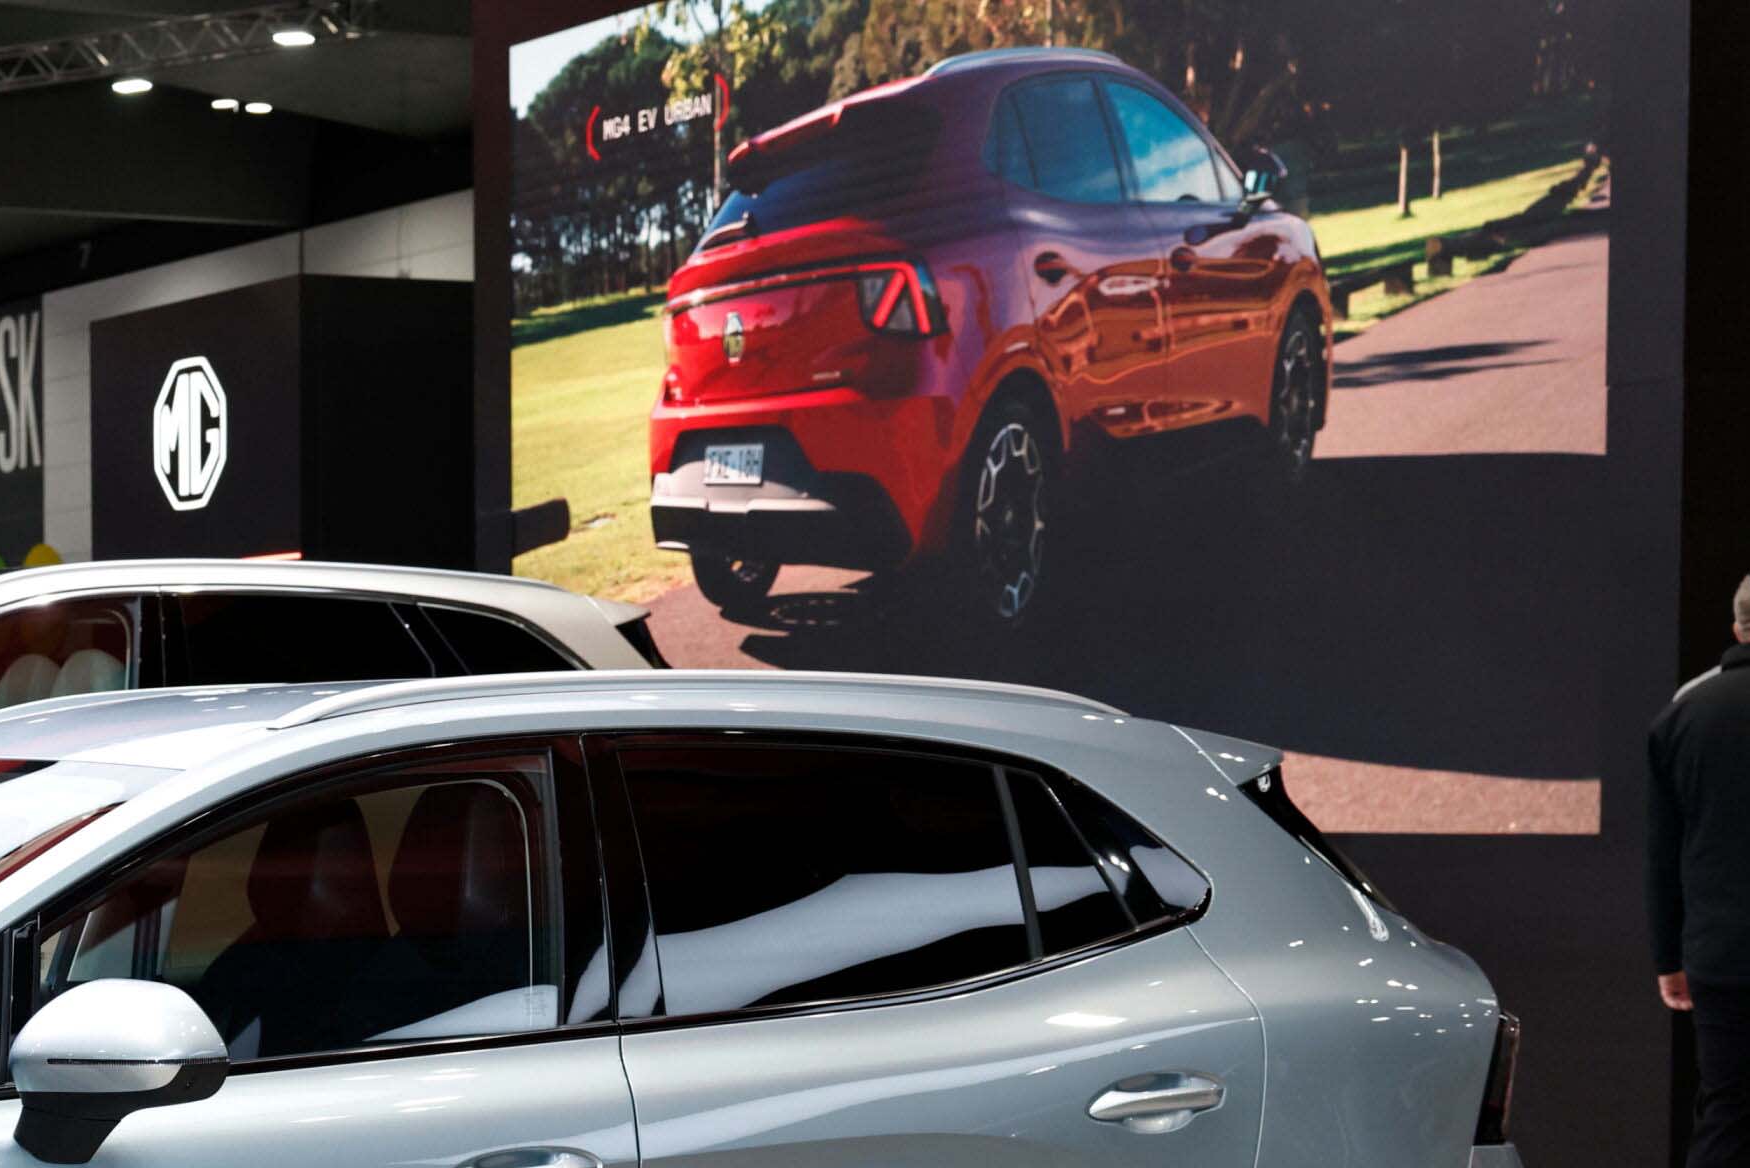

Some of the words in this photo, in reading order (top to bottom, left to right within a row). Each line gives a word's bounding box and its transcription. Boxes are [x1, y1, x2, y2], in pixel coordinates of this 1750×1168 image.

[602, 114, 631, 141] MG4
[637, 107, 658, 133] EV
[664, 93, 712, 126] URBAN
[157, 362, 224, 504] MG
